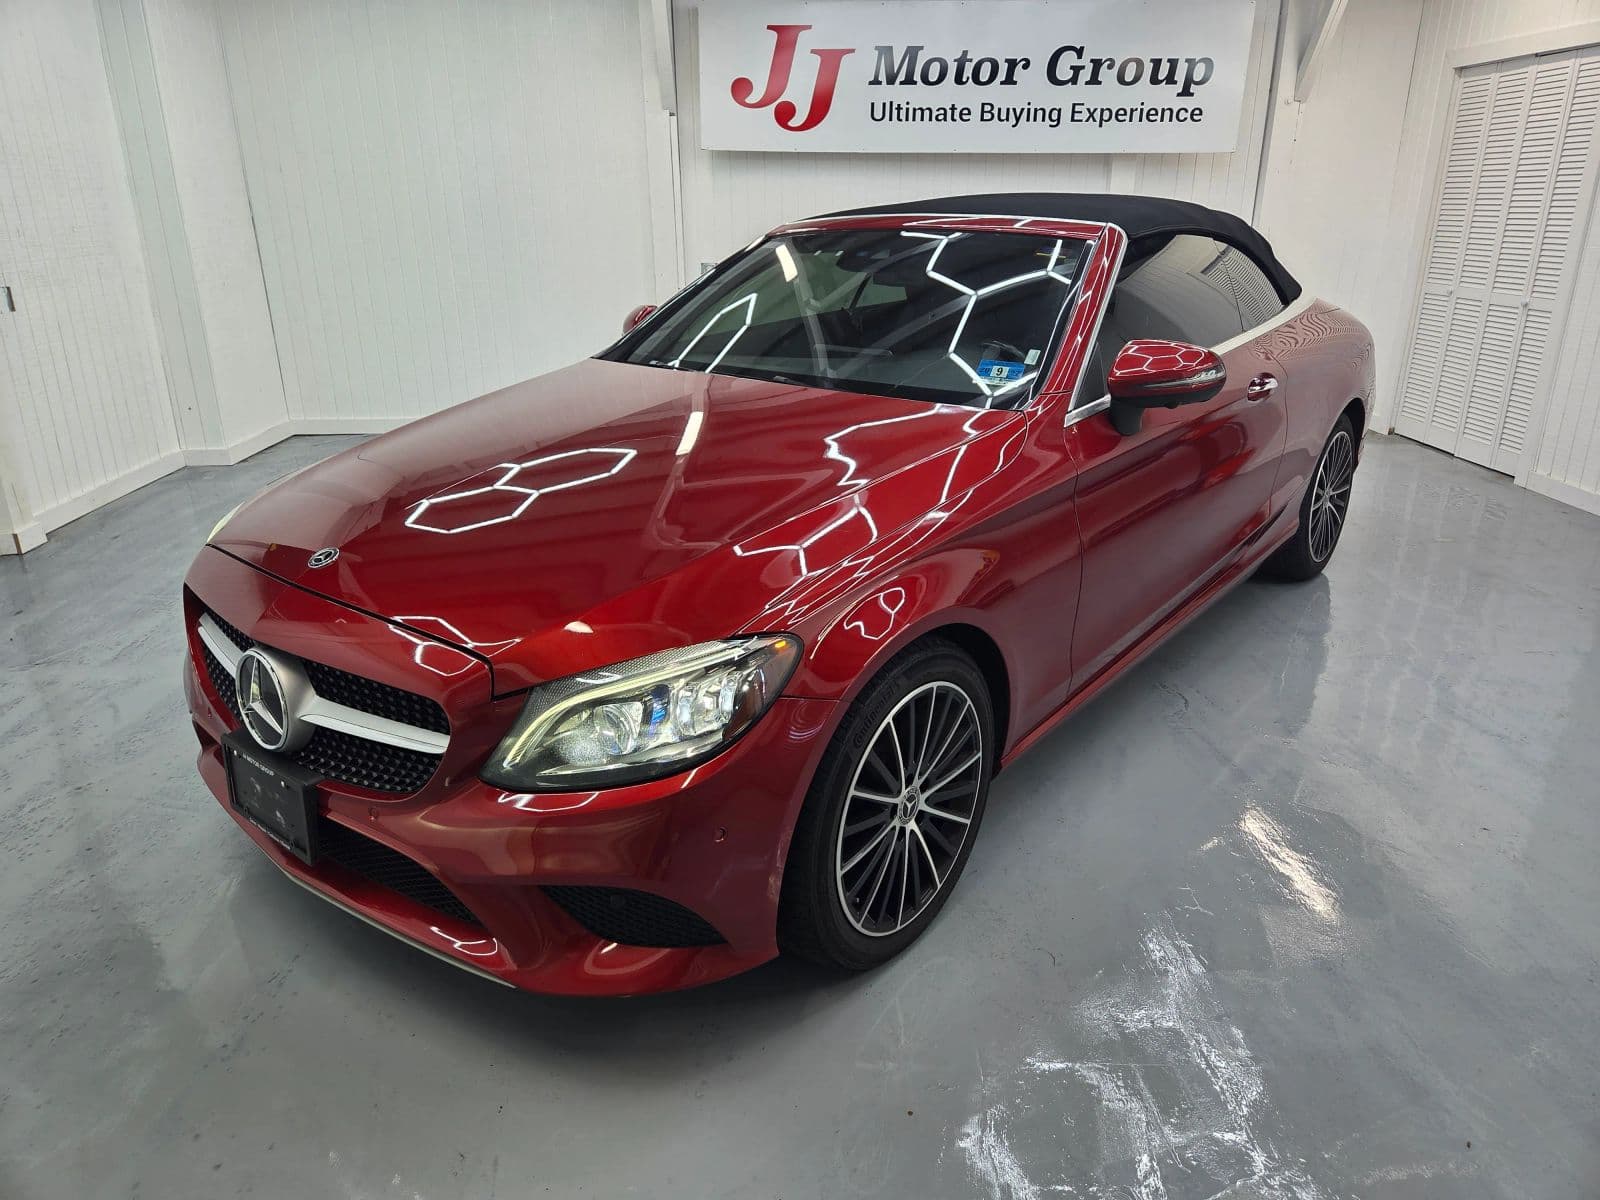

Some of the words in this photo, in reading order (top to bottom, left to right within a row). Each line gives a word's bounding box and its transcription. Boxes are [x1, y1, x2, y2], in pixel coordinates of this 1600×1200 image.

[731, 25, 856, 132] JJ
[868, 46, 1030, 86] Motor
[1047, 46, 1213, 97] Group
[871, 101, 971, 122] Ultimate
[980, 102, 1061, 128] Buying
[1070, 102, 1203, 128] Experience
[995, 367, 1003, 376] 9
